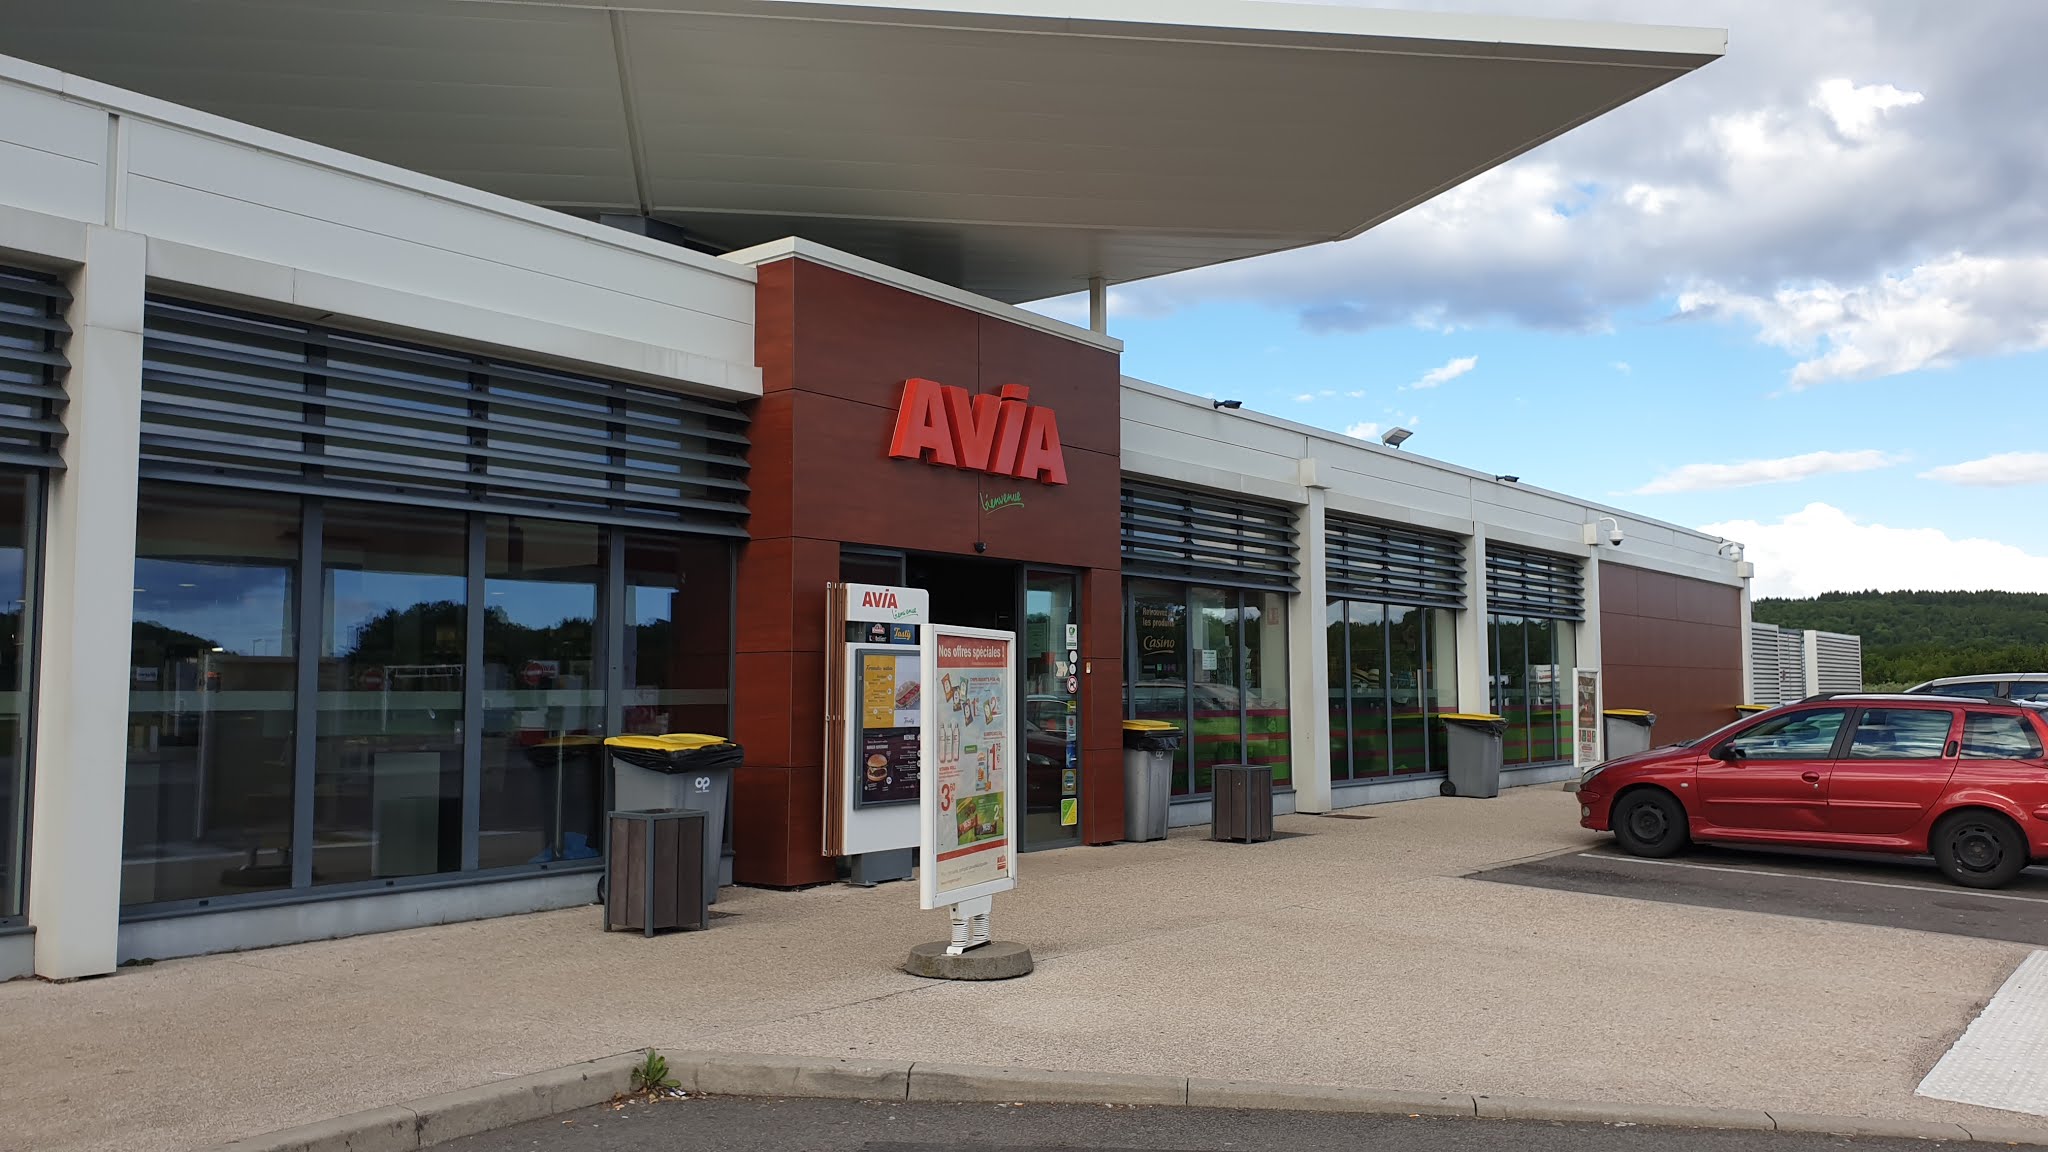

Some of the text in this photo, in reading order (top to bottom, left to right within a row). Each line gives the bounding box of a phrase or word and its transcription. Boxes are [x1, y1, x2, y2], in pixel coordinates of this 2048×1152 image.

[889, 378, 1068, 485] AVIA
[862, 589, 898, 609] AVIA
[1142, 618, 1151, 627] les
[1143, 635, 1175, 650] Casino
[938, 644, 952, 658] Nos
[952, 644, 972, 658] offres
[972, 645, 1001, 660] spéciales
